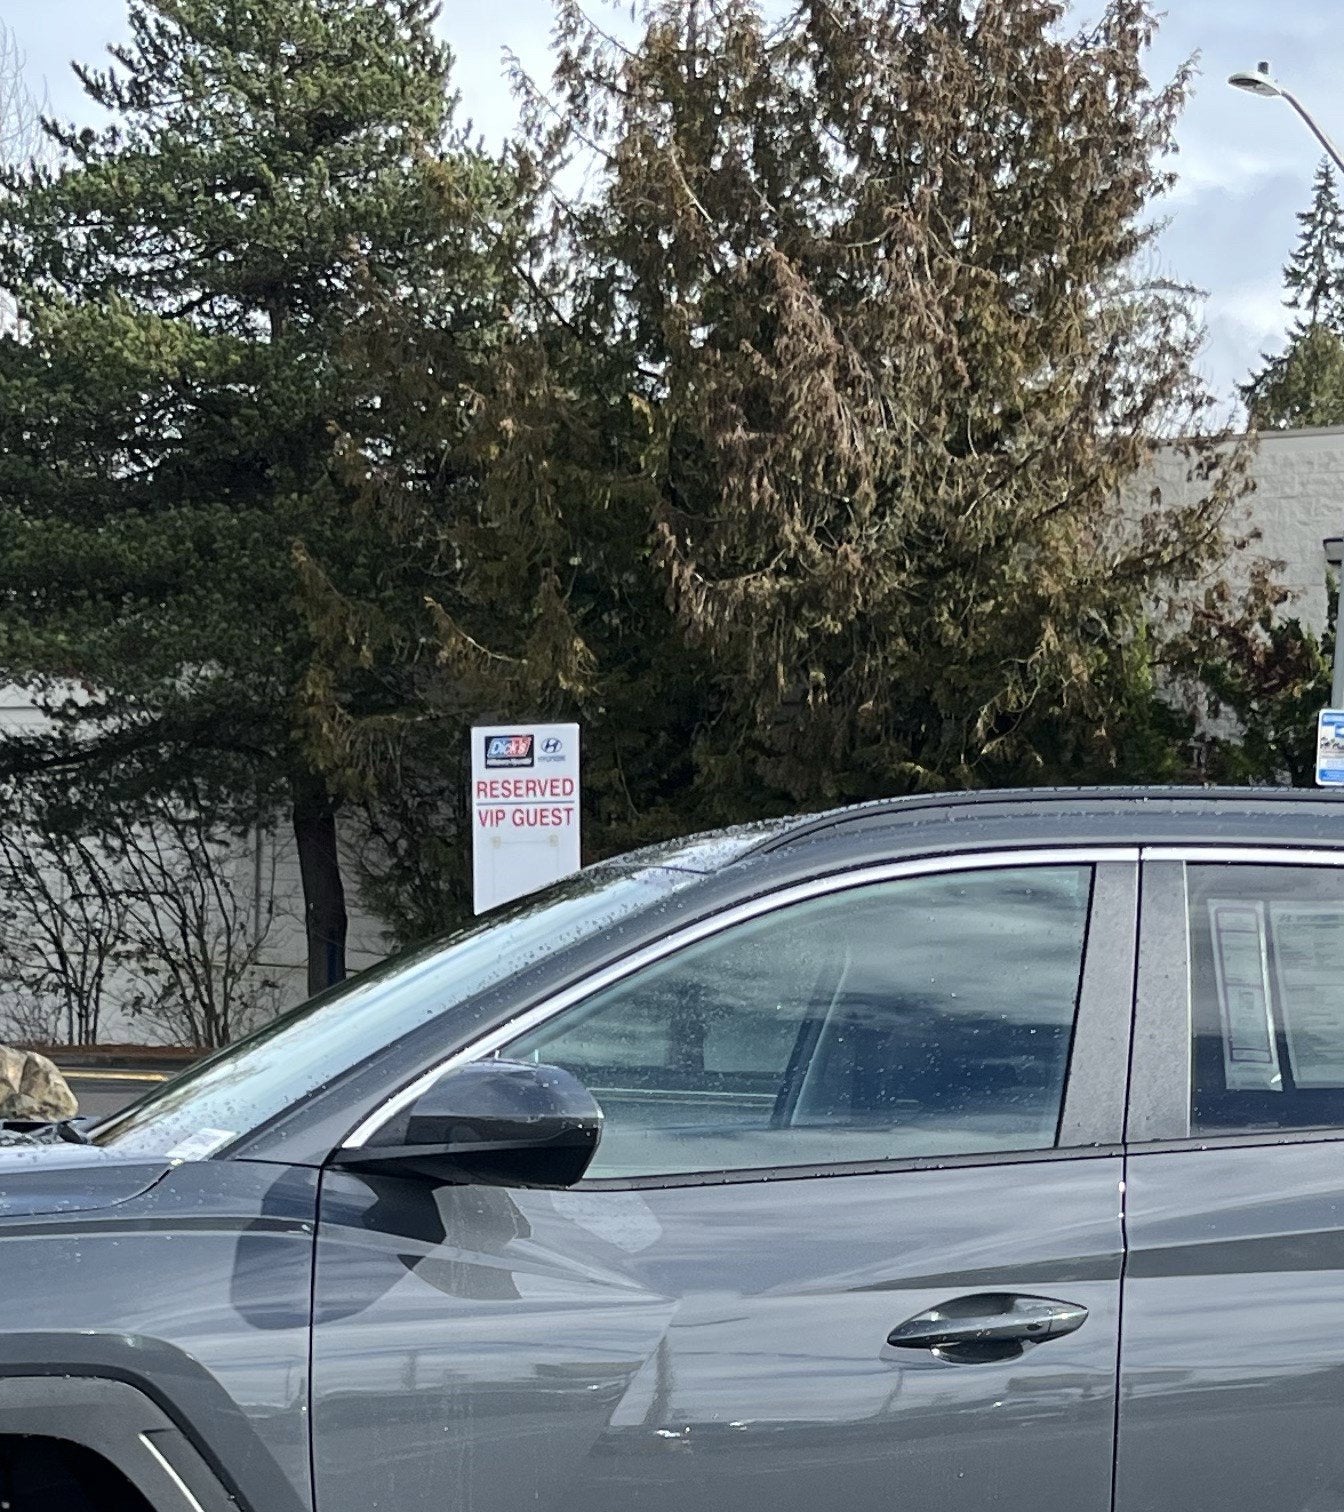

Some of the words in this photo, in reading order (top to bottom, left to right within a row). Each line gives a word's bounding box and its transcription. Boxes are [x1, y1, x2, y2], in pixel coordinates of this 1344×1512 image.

[477, 778, 574, 798] RESERVED
[479, 808, 506, 827] VIP
[512, 807, 574, 827] GUEST
